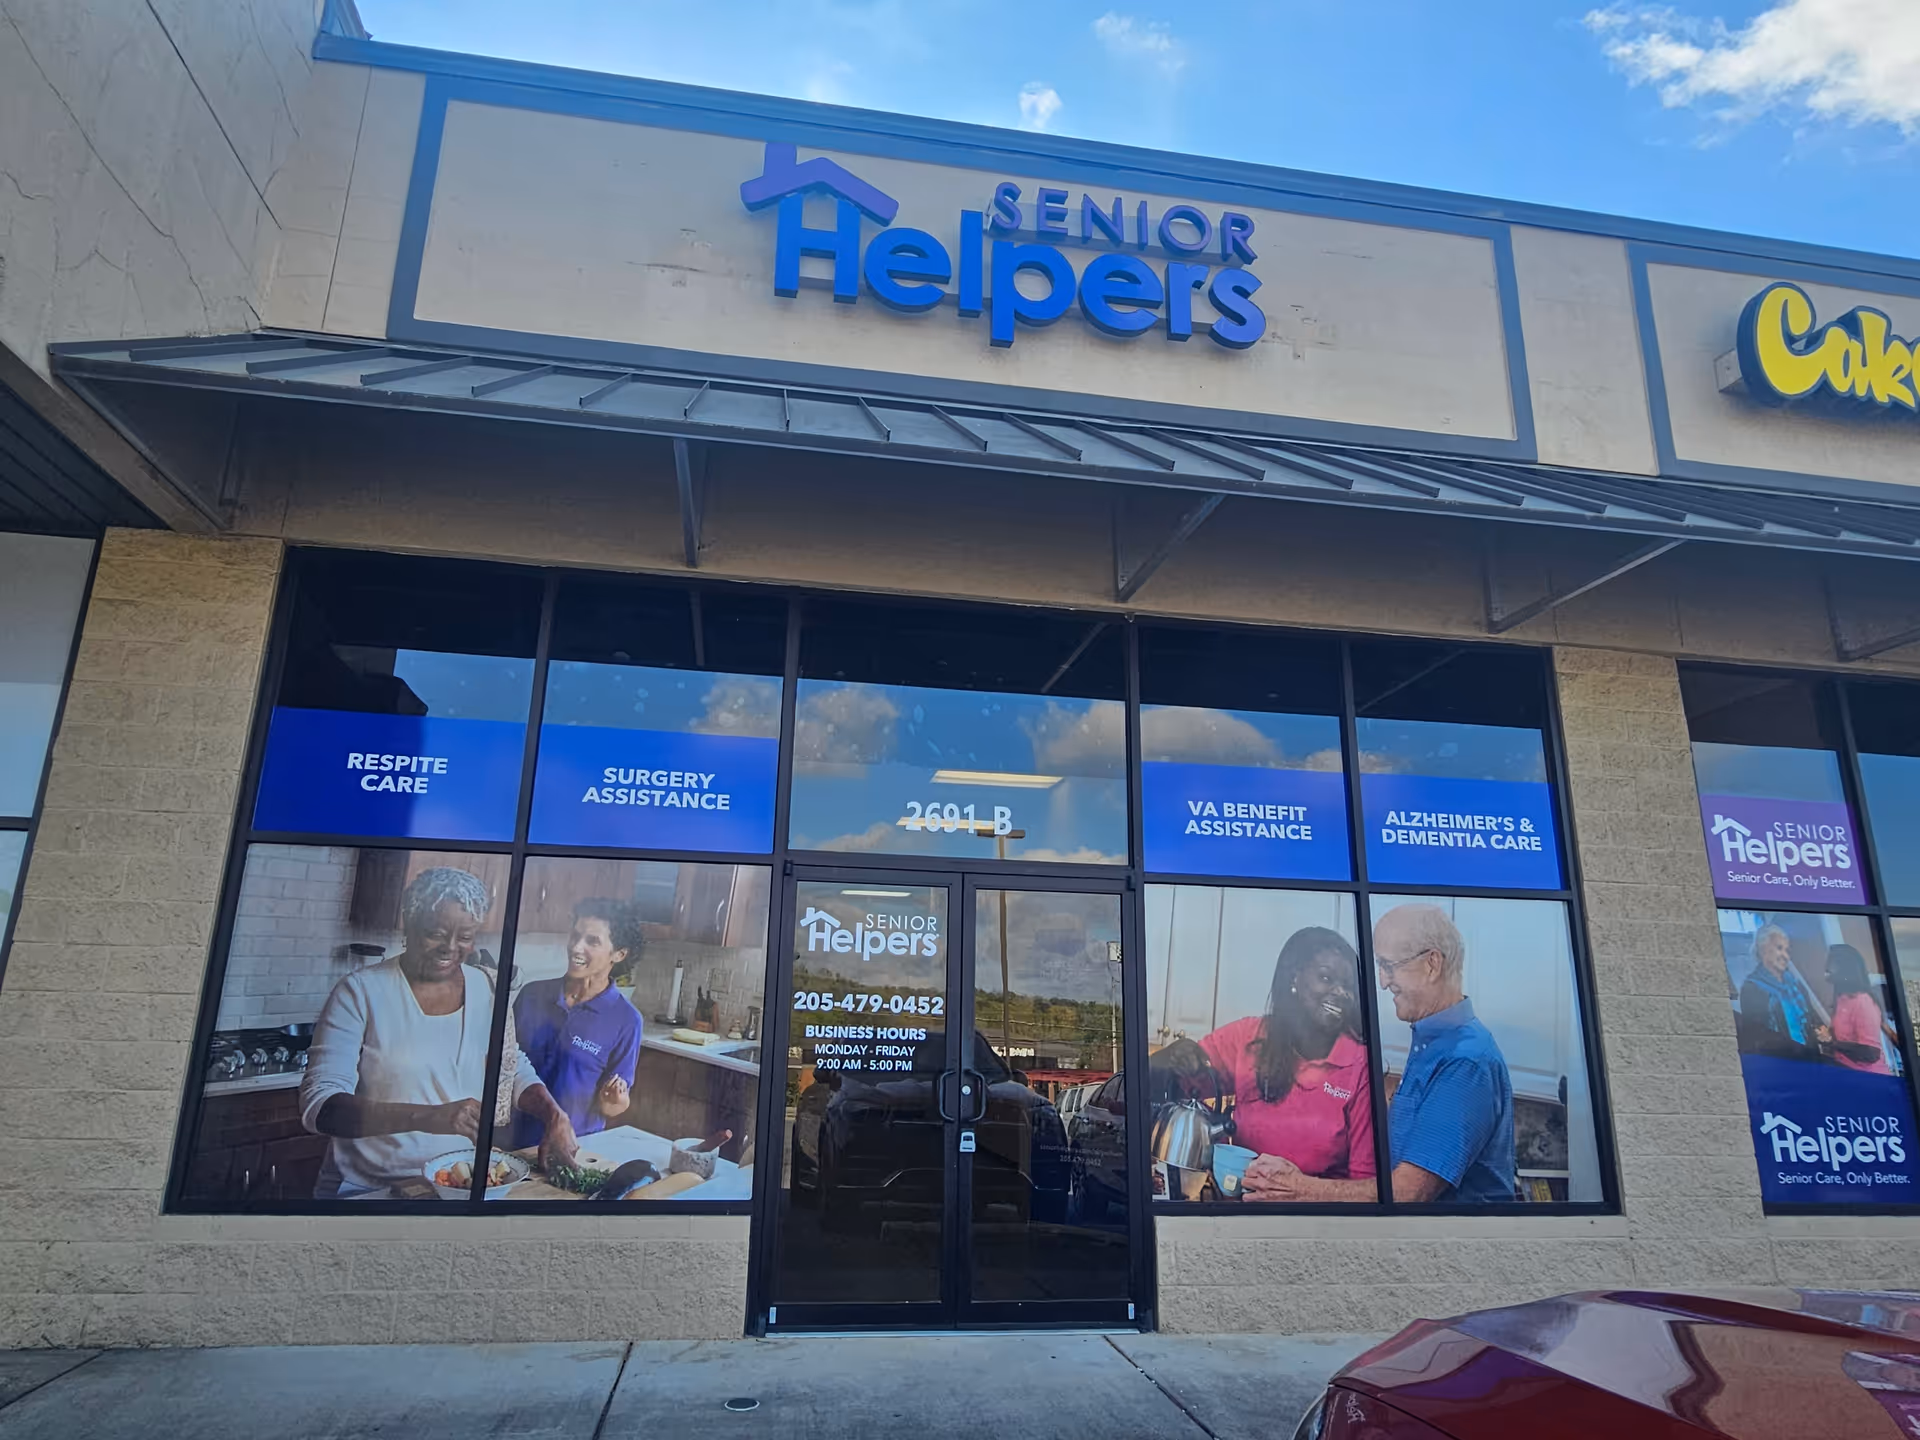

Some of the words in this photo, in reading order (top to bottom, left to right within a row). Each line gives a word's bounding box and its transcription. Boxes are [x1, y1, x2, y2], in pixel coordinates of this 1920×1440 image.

[992, 180, 1258, 266] SENIOR
[773, 192, 1268, 350] Helpers
[1739, 281, 1920, 411] Cak
[347, 752, 449, 774] RESPITE
[360, 774, 430, 794] CARE
[602, 767, 716, 790] SURGERY
[582, 786, 731, 811] ASSISTANCE
[905, 801, 975, 834] 2691
[1188, 801, 1219, 817] VA
[1222, 803, 1308, 822] BENEFIT
[1385, 811, 1515, 832] ALZHEIMER'S
[1519, 818, 1536, 833] &
[1184, 820, 1313, 841] ASSISTANCE
[1382, 828, 1488, 849] DEMENTIA
[1490, 834, 1543, 851] CARE
[1774, 821, 1847, 842] SENIOR
[1721, 830, 1851, 874] Helpers
[1727, 871, 1761, 884] Senior
[1763, 873, 1792, 887] Care,
[1794, 875, 1819, 890] Only
[1821, 877, 1856, 889] Better.
[865, 913, 937, 932] SENIOR
[808, 922, 938, 961] Helpers
[793, 991, 945, 1016] 205-479-0452
[805, 1025, 874, 1040] BUSINESS
[876, 1027, 927, 1041] HOURS
[814, 1043, 868, 1056] MONDAY
[875, 1045, 916, 1057] FRIDAY
[816, 1058, 841, 1070] 9:00
[842, 1059, 861, 1070] AM
[869, 1059, 893, 1071] 5:00
[895, 1060, 913, 1071] PM
[1825, 1116, 1900, 1134] SENIOR
[1770, 1126, 1906, 1171] Helpers
[1777, 1172, 1812, 1184] Senior
[1815, 1172, 1845, 1185] Care,
[1846, 1172, 1872, 1186] Only
[1874, 1173, 1911, 1184] Better.
